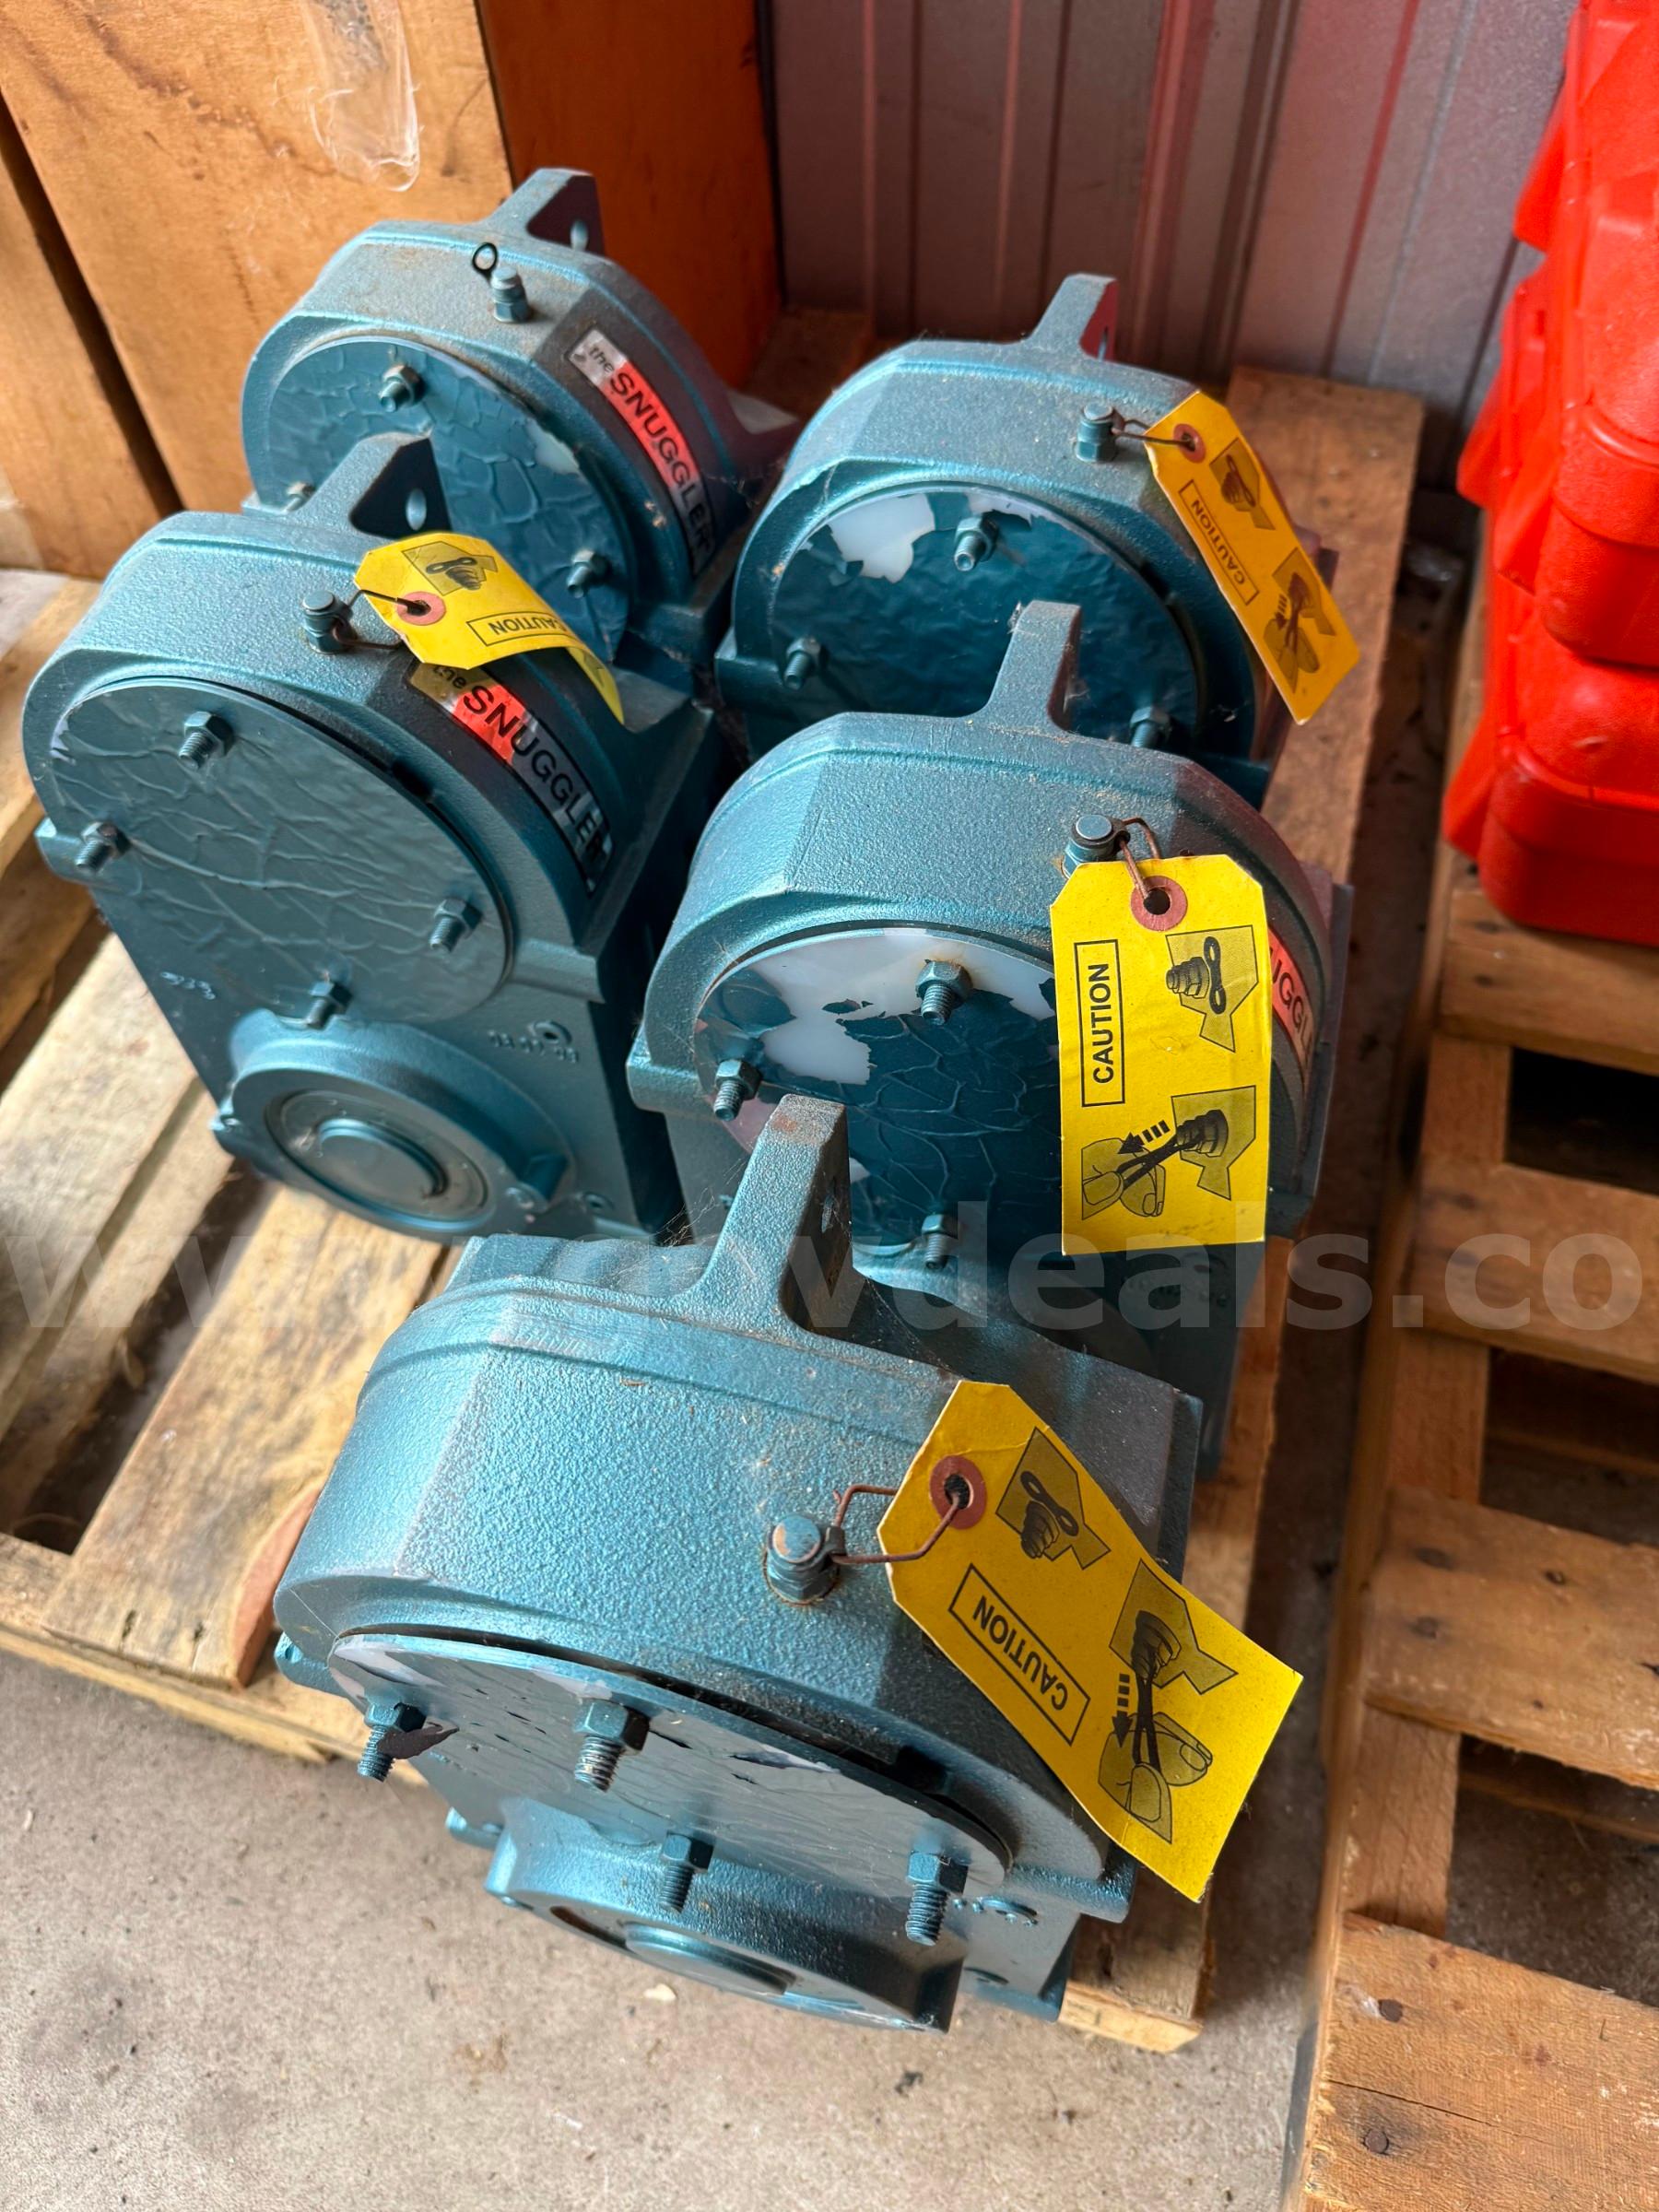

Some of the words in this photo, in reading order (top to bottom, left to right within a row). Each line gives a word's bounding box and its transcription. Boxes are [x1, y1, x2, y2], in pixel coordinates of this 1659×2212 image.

[588, 347, 615, 373] the
[609, 371, 712, 553] SNUGGLER
[1191, 499, 1245, 585] CAUTION
[463, 685, 605, 863] SNUGGLER
[1088, 962, 1115, 1085] CAUTION
[971, 1594, 1069, 1712] CAUTION
